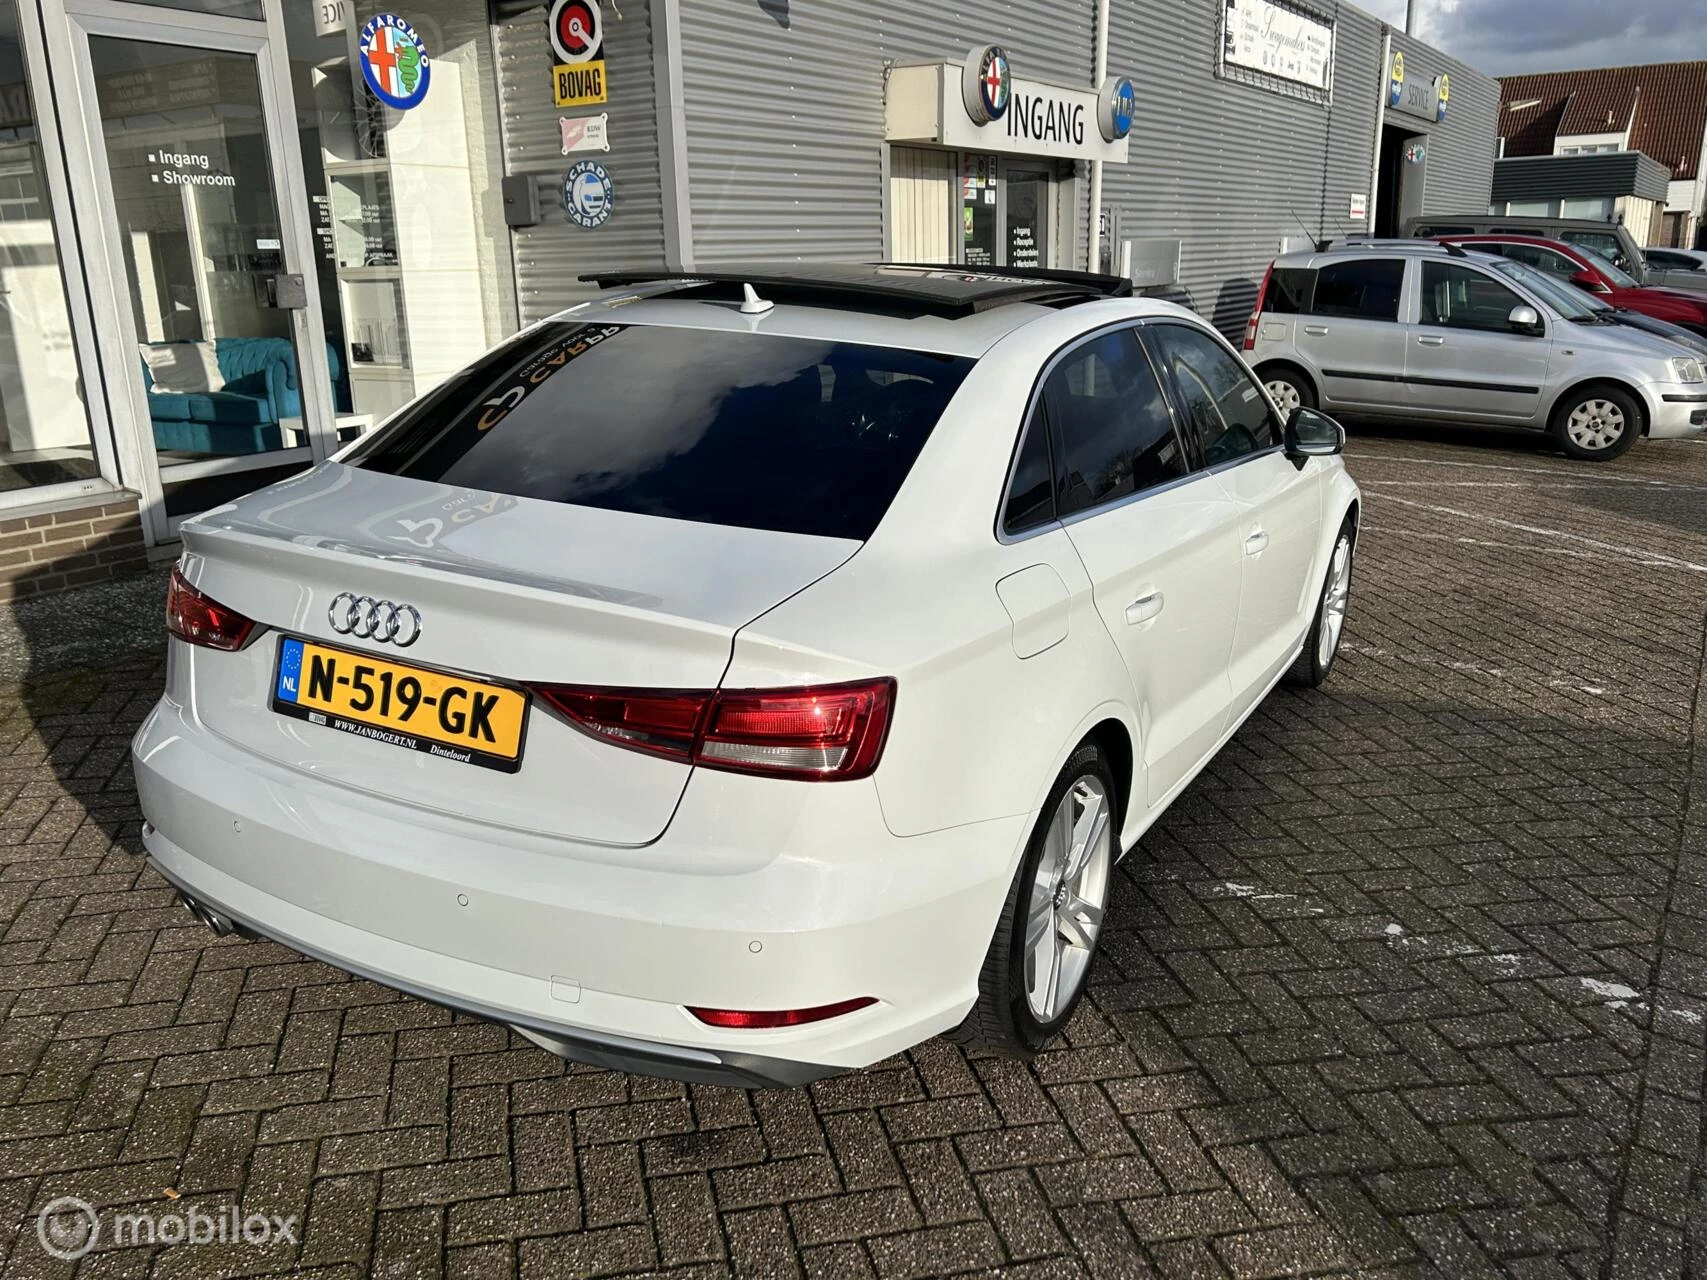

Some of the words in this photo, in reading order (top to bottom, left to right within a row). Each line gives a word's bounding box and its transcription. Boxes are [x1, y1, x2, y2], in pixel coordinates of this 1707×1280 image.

[558, 68, 602, 99] BOVAG
[1408, 84, 1429, 110] SERVICE
[1007, 93, 1084, 145] INGANG
[159, 150, 209, 169] Ingang
[163, 170, 236, 187] Showroom
[565, 161, 611, 193] SCHADE
[567, 198, 613, 228] GARANT
[1016, 226, 1031, 236] Ingang
[282, 674, 297, 692] NL
[307, 653, 500, 744] N-519-GK
[334, 718, 418, 750] WWW.JANBOGERT.NL
[430, 744, 471, 763] Dinteloord
